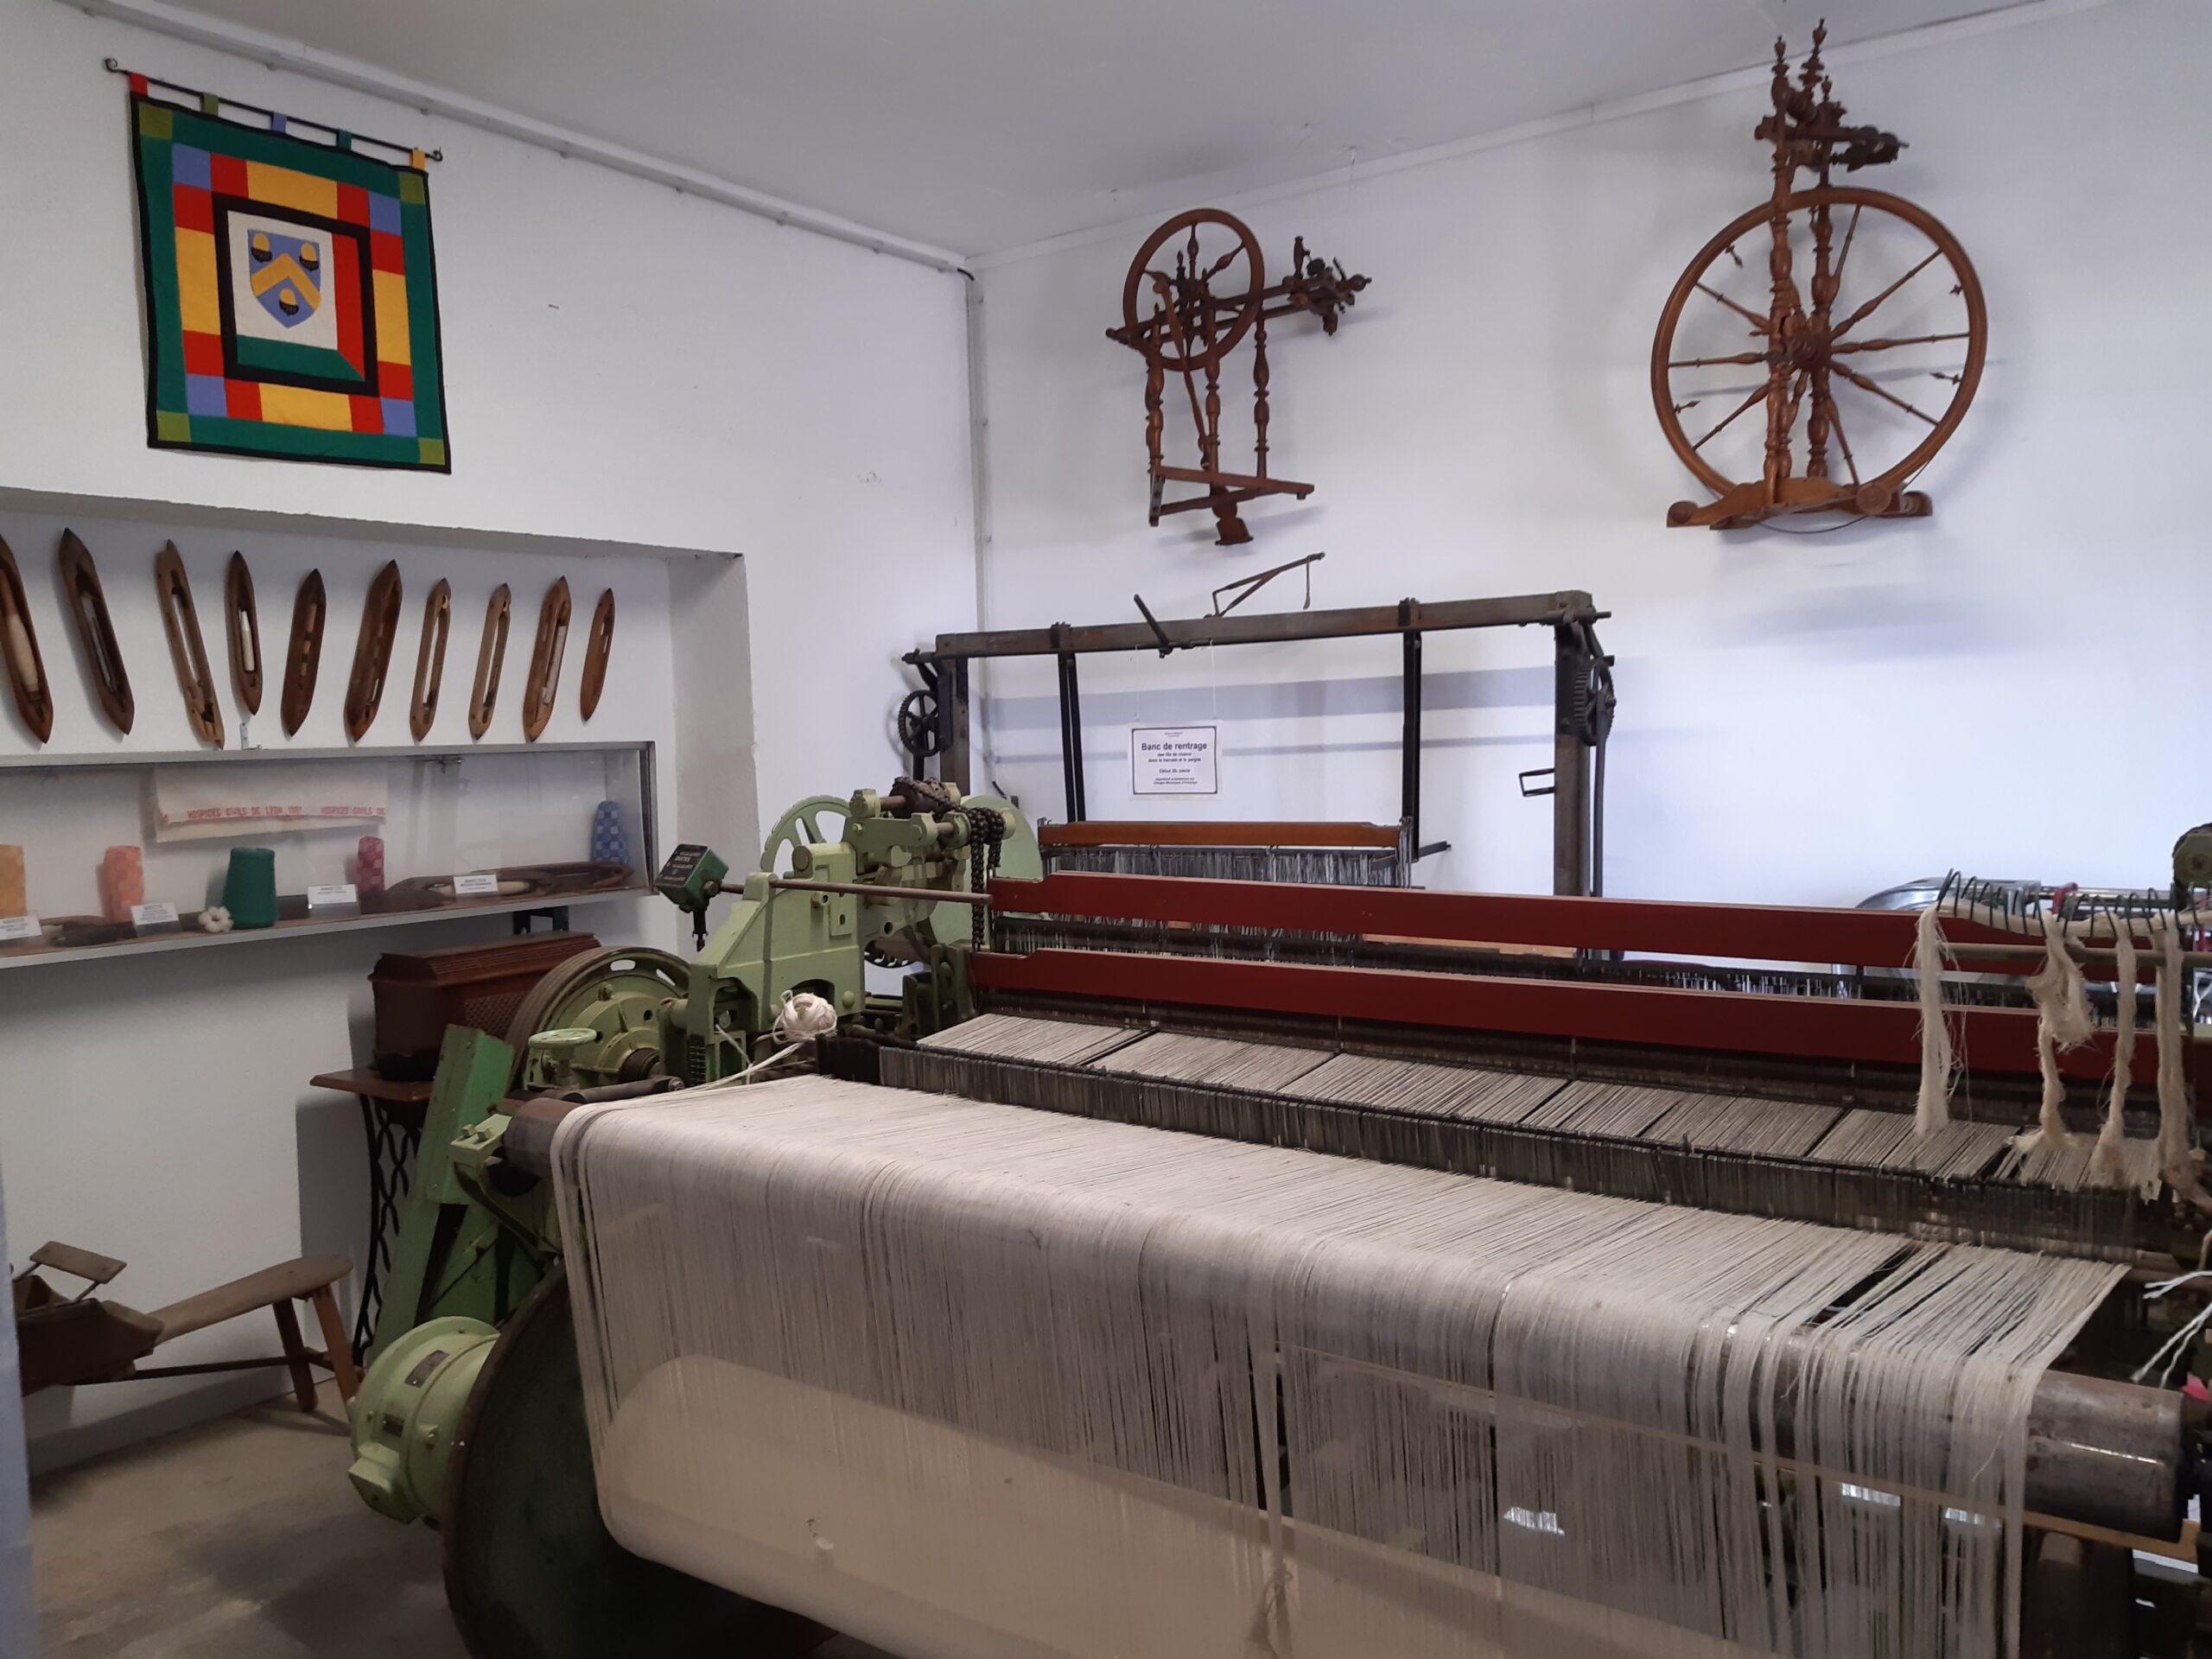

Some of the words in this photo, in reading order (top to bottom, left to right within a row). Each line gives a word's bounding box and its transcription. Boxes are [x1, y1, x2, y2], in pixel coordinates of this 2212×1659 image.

[1141, 742, 1161, 751] Banc
[1163, 742, 1173, 751] de
[1174, 742, 1207, 752] rentrage
[251, 806, 261, 815] DE
